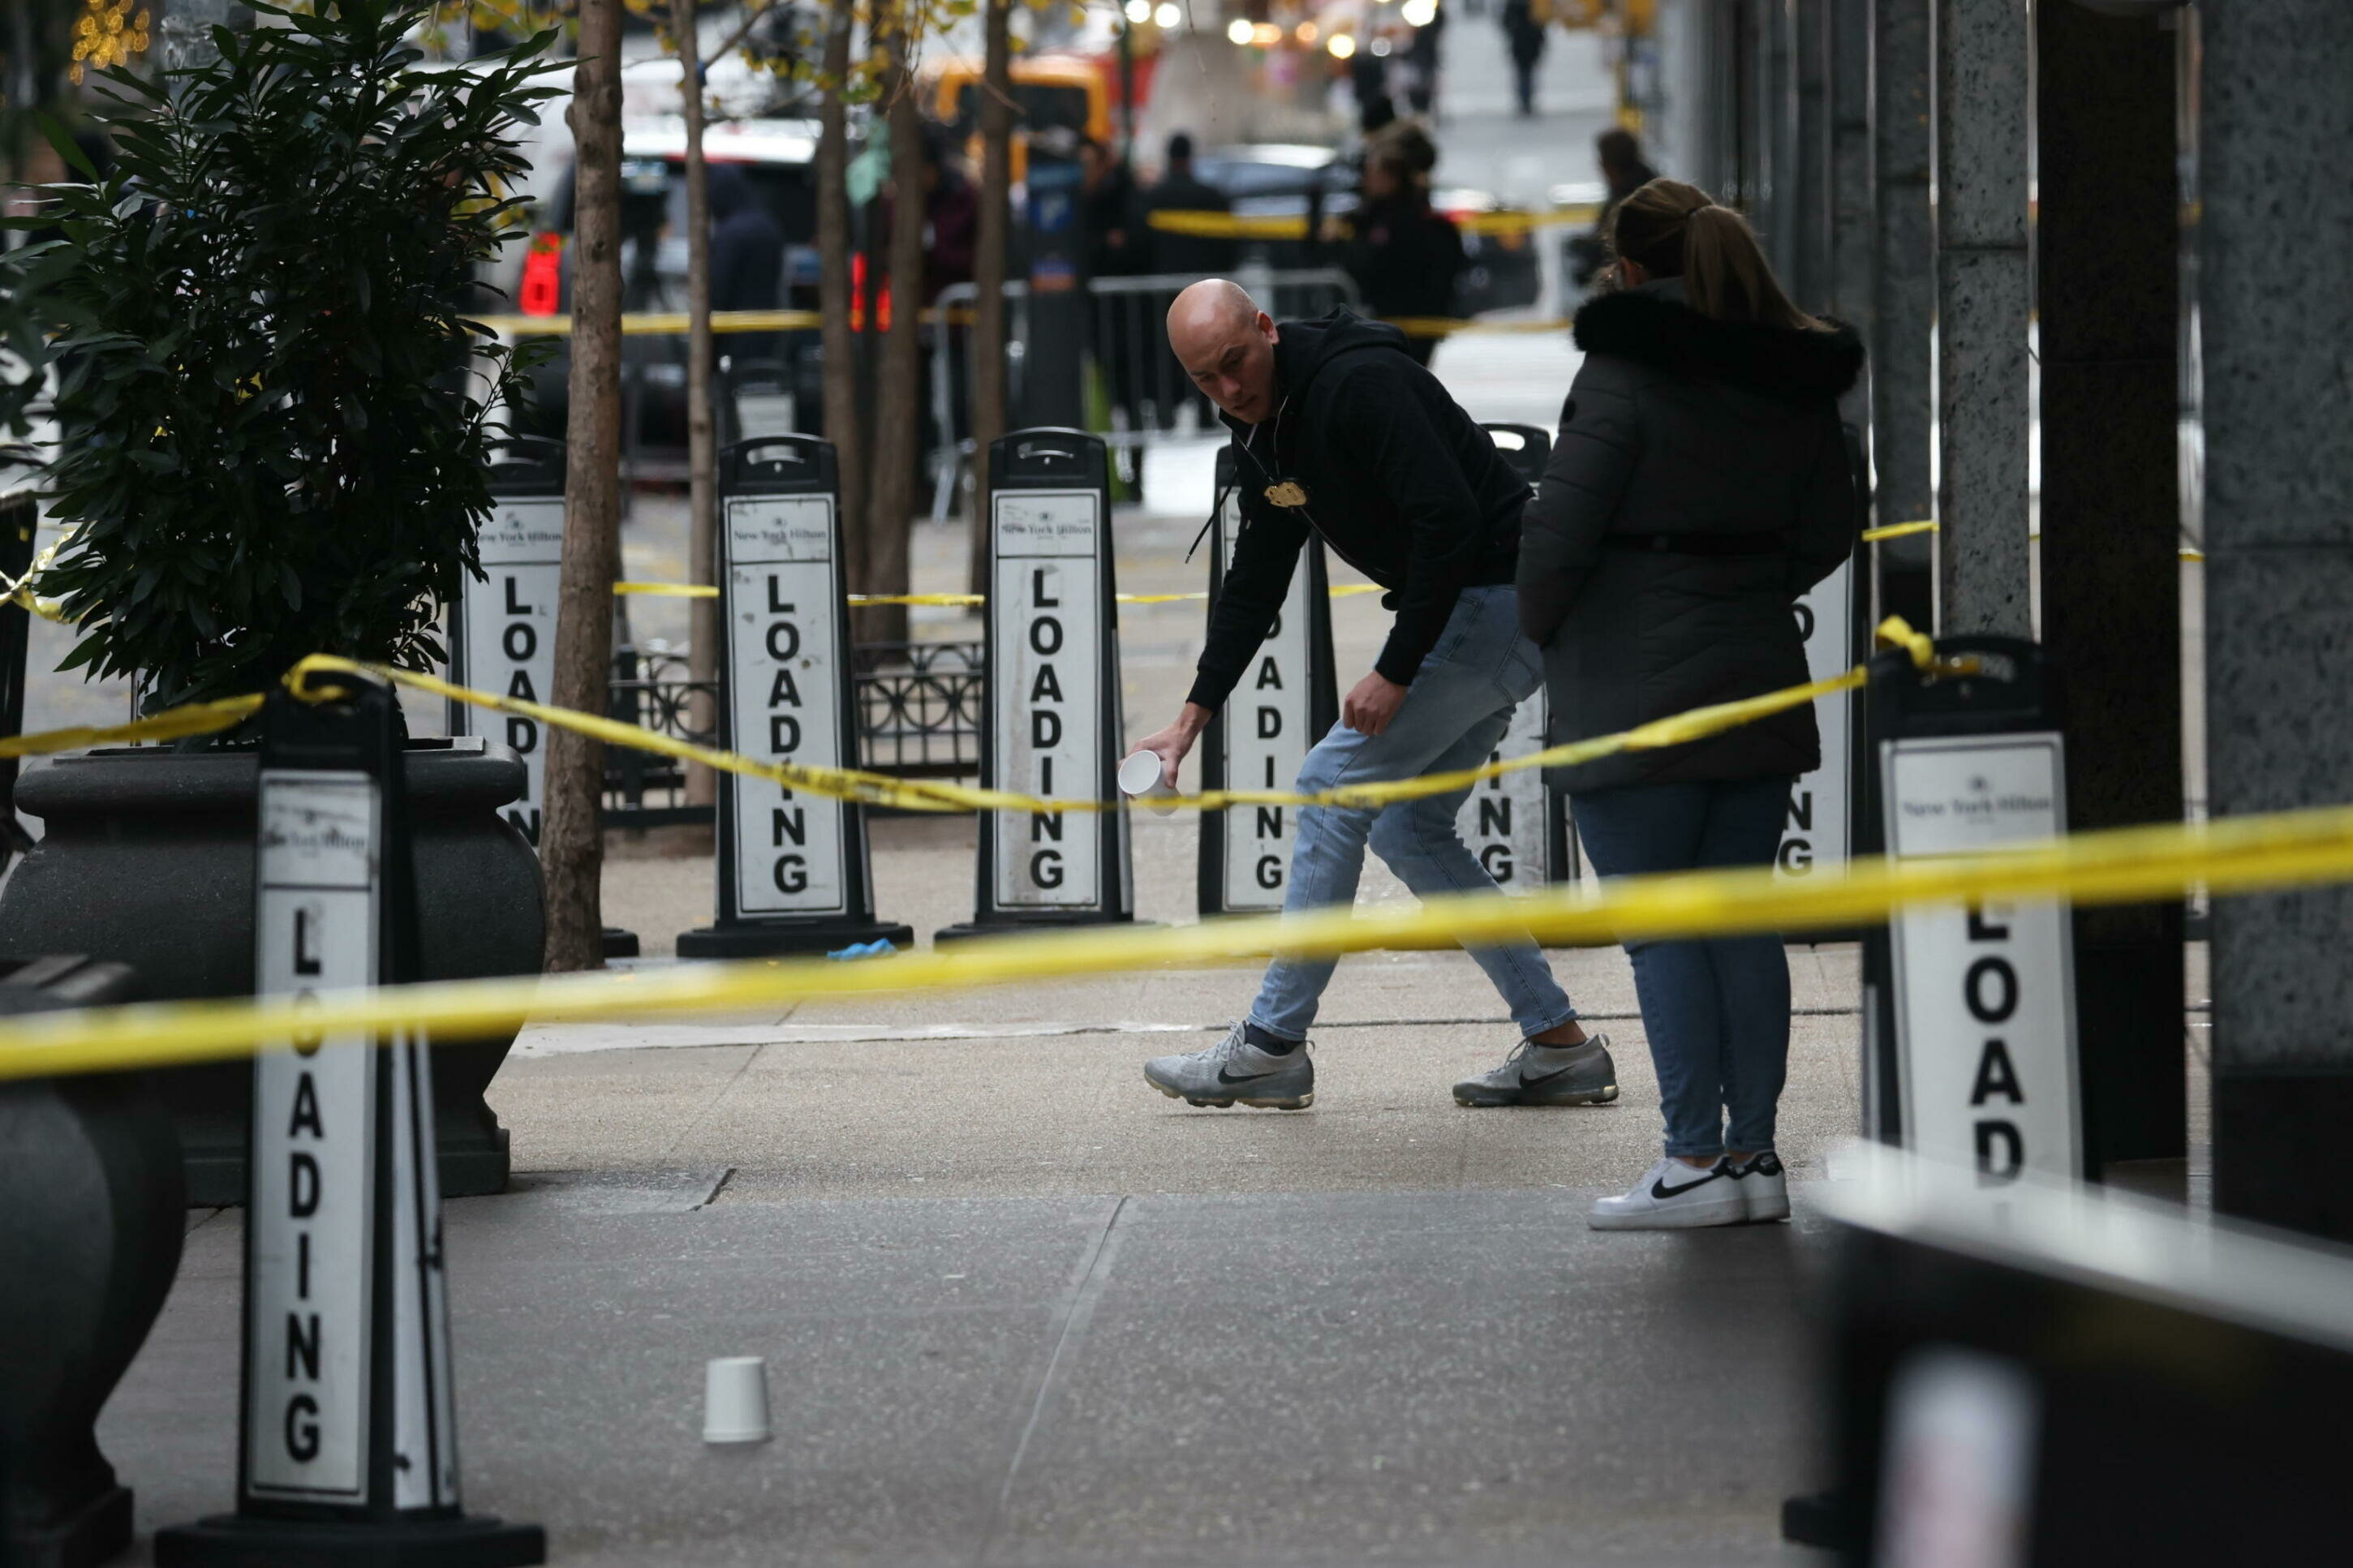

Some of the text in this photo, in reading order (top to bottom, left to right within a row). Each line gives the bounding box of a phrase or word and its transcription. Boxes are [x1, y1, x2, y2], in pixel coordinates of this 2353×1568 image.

[789, 528, 827, 539] Hilton
[502, 576, 541, 848] LOADIN
[765, 574, 808, 894] LOADING
[1029, 569, 1065, 890] LOADING
[1255, 612, 1284, 890] ADING
[283, 907, 325, 1463] LOADING
[1964, 891, 2026, 1190] LOAD
